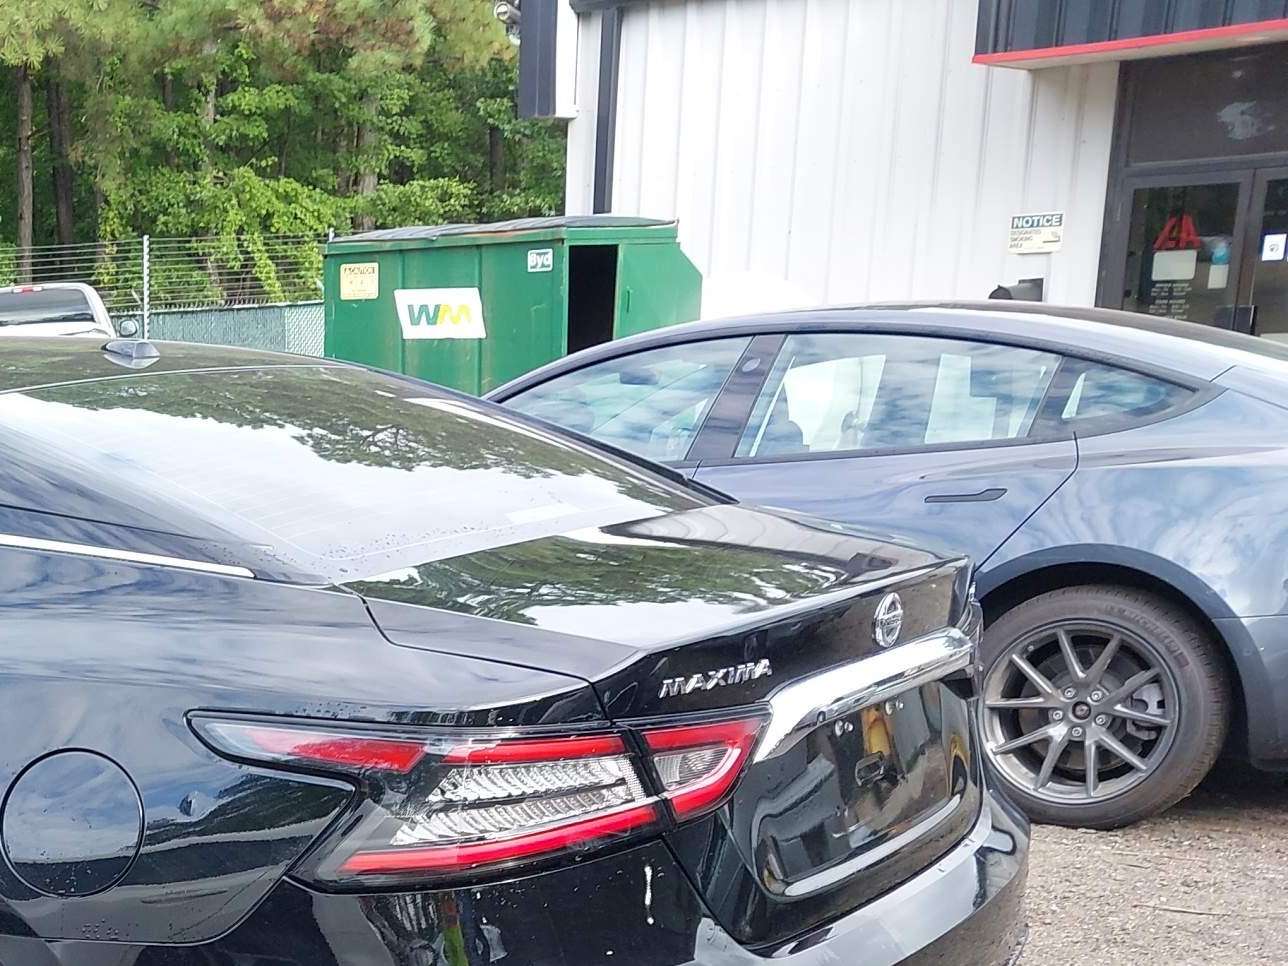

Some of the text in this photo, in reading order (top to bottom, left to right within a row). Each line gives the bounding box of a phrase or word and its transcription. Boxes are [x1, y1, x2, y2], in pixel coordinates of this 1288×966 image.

[1014, 215, 1061, 227] NOTICE
[408, 304, 472, 326] WM
[658, 658, 773, 699] MAXIMA
